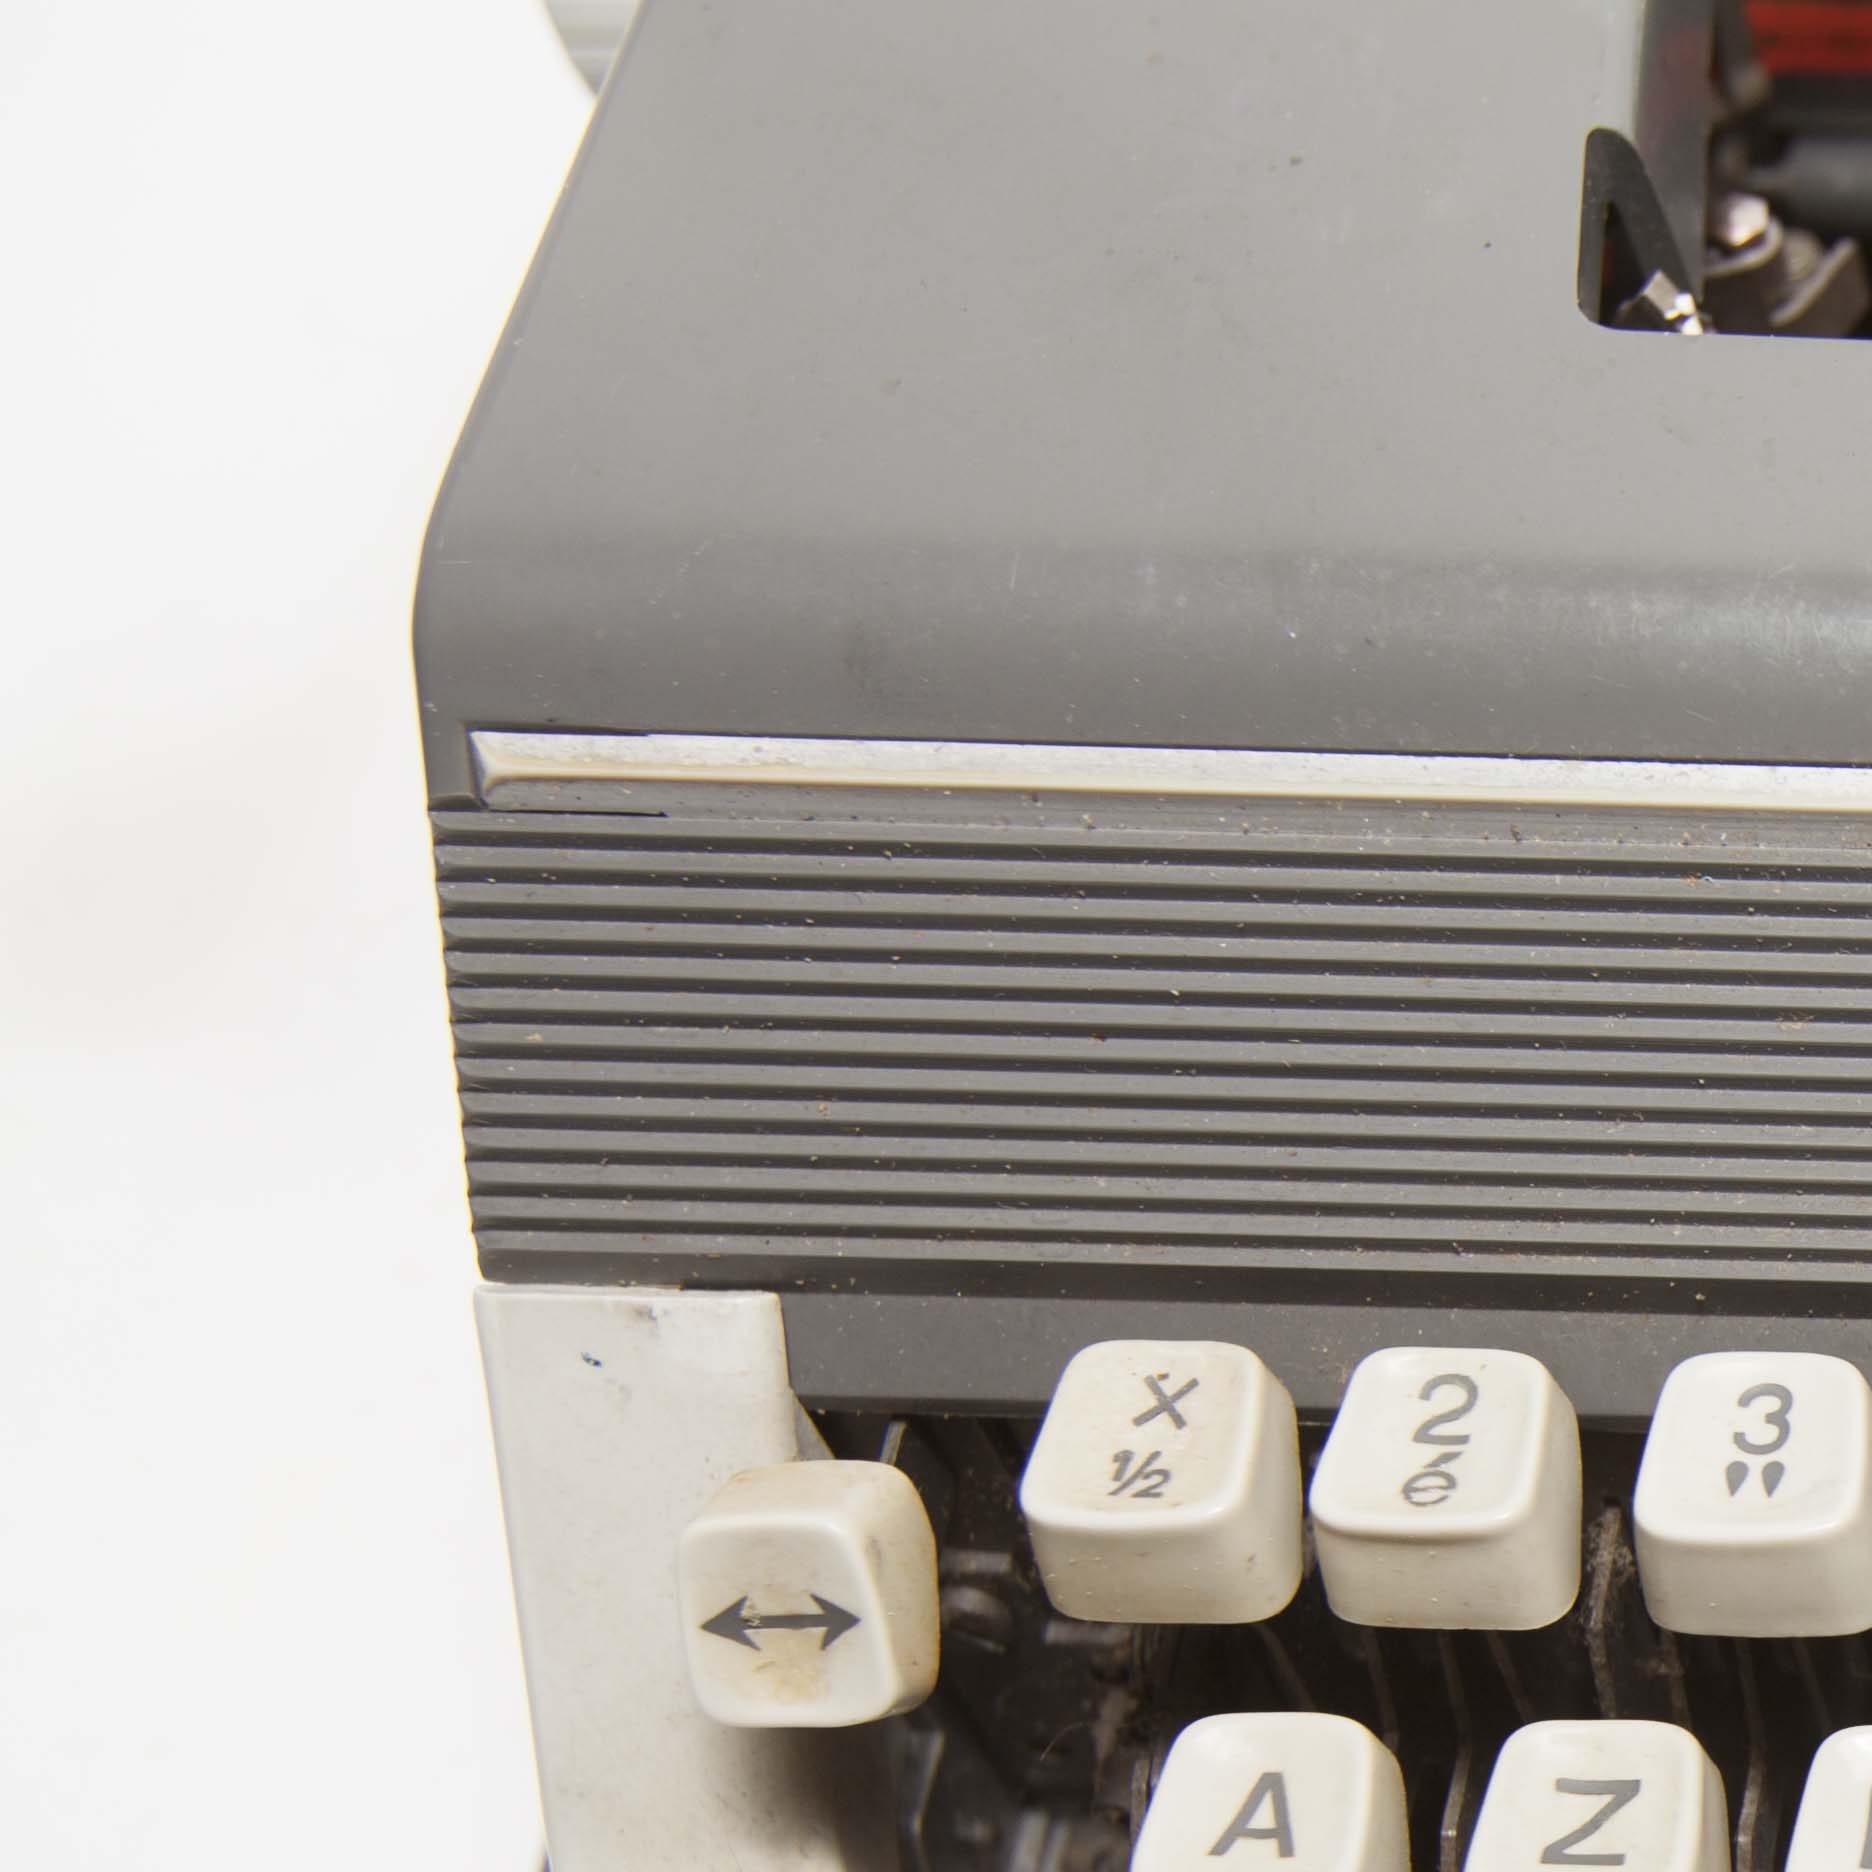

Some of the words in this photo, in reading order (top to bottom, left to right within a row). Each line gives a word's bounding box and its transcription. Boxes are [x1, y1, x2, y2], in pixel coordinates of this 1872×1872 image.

[1410, 1372, 1481, 1448] 2
[1731, 1381, 1795, 1457] 3
[1206, 1770, 1297, 1860] A
[1538, 1776, 1643, 1868] Z
